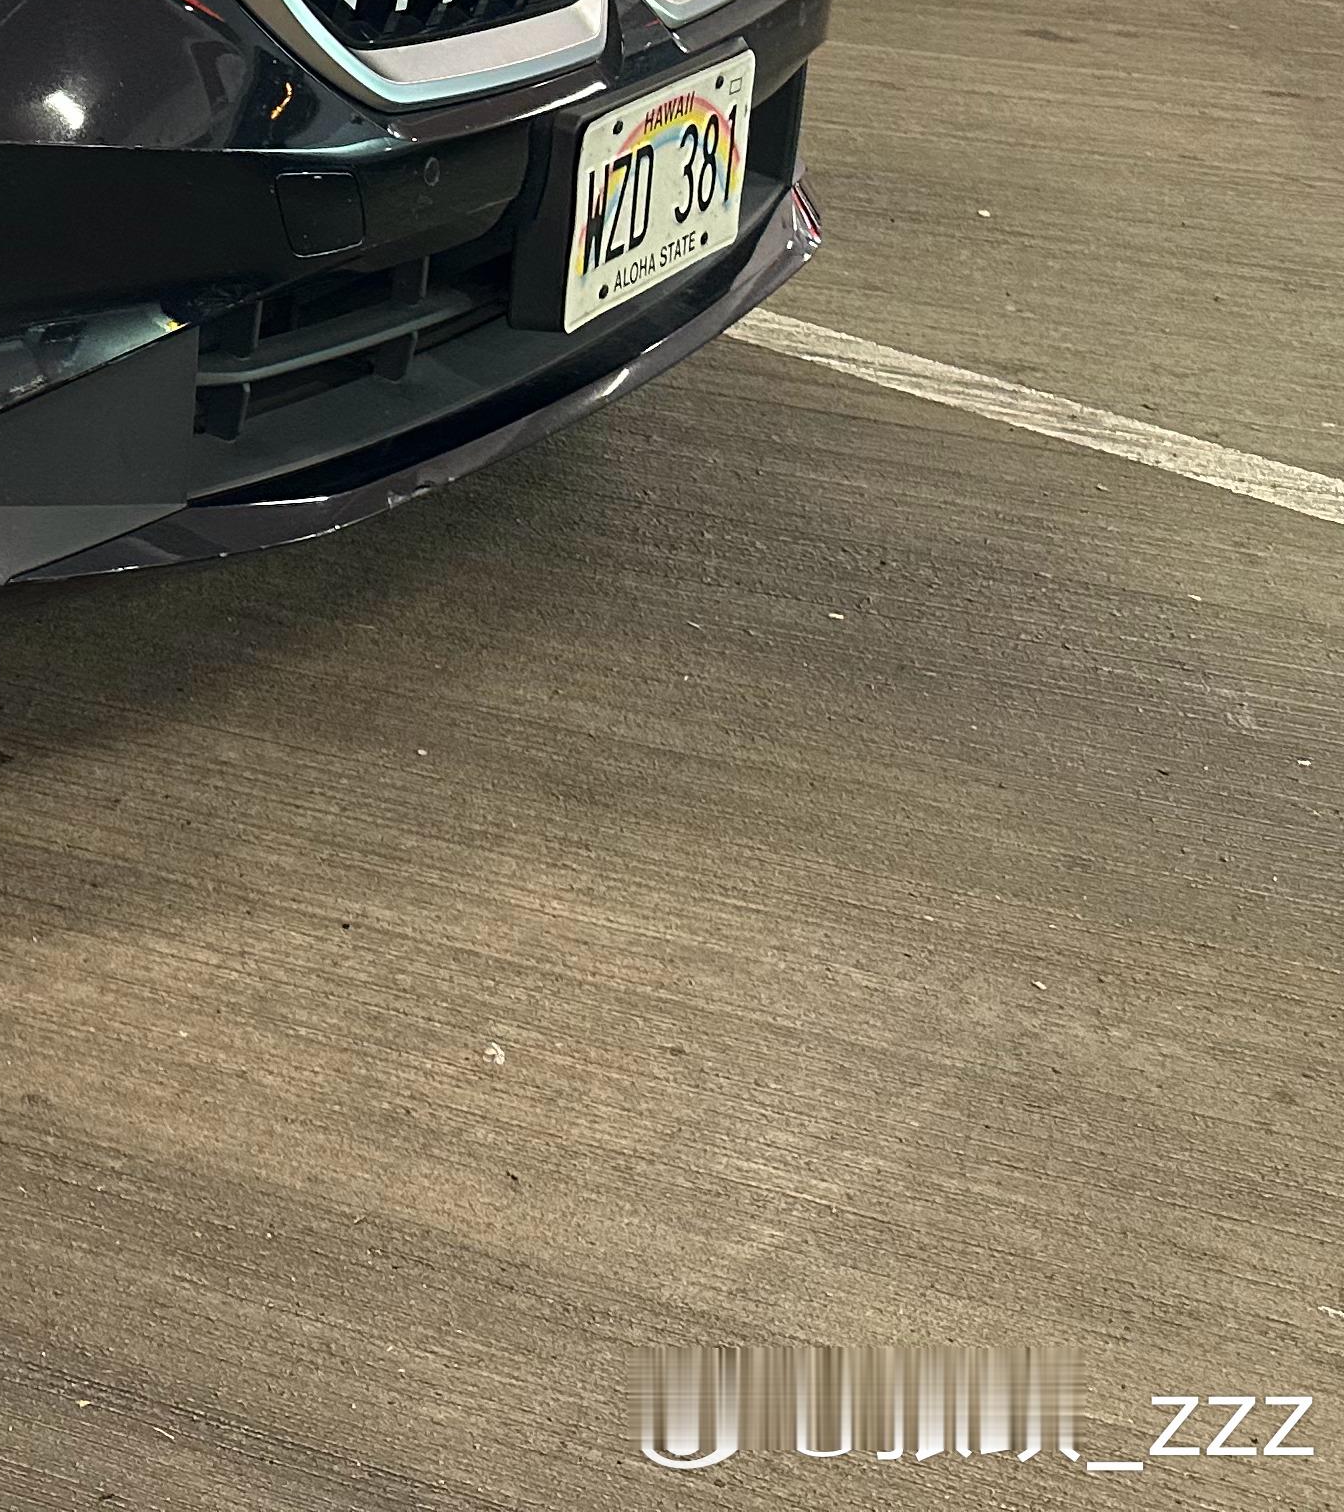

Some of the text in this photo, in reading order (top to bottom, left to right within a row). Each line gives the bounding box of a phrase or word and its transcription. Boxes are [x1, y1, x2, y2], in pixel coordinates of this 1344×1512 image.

[644, 91, 696, 134] HAWAII
[582, 104, 738, 276] WZD 381
[613, 231, 697, 292] ALOHA STATE
